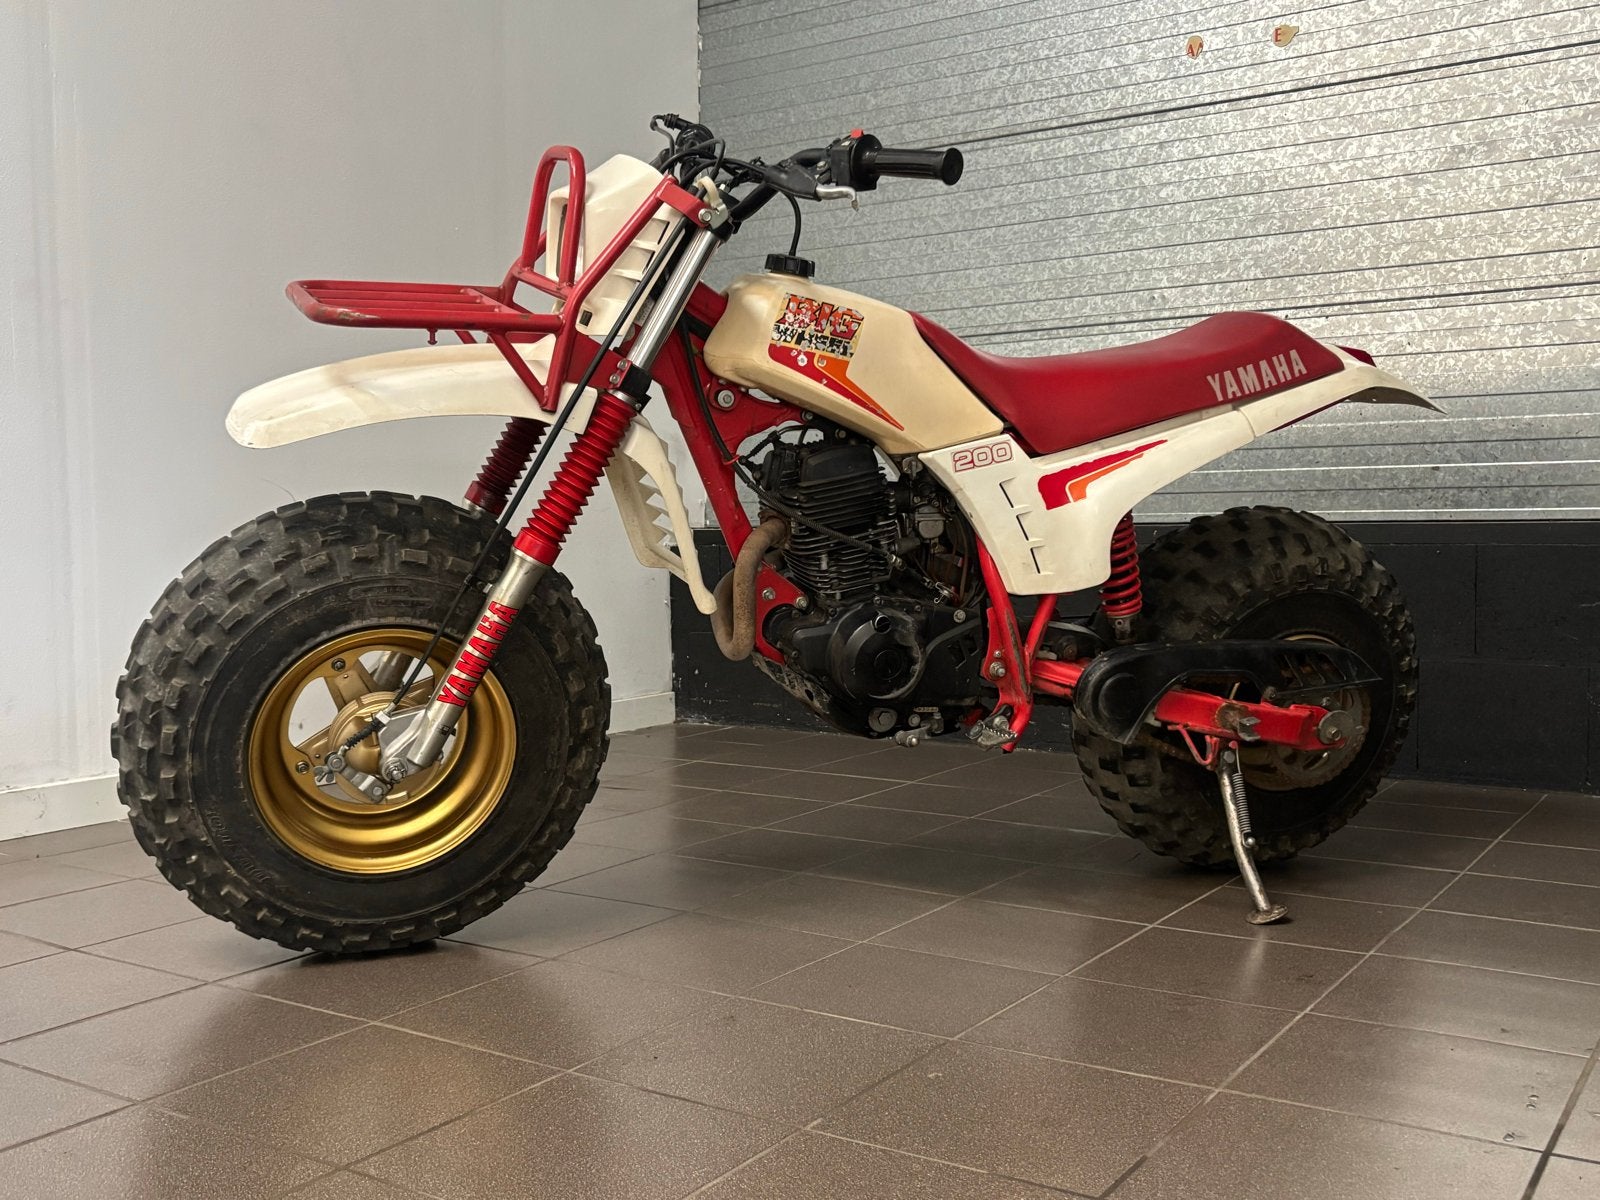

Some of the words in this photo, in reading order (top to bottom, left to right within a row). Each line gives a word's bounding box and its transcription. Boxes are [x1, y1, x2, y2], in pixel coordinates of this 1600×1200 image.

[775, 293, 865, 341] BIG
[1206, 349, 1308, 402] YAMAHA
[952, 441, 1013, 473] 200
[436, 600, 520, 708] YAMAHA
